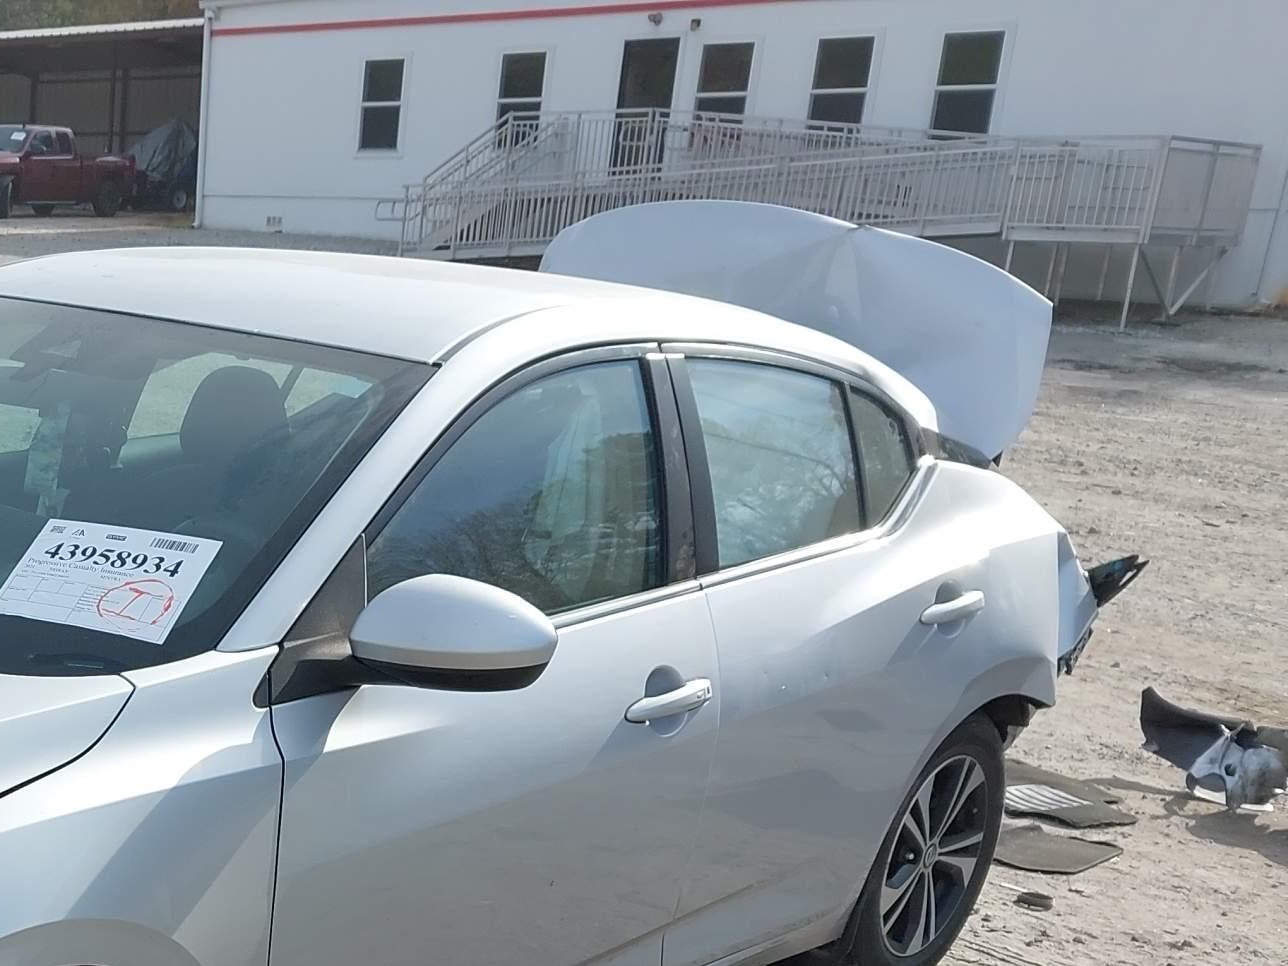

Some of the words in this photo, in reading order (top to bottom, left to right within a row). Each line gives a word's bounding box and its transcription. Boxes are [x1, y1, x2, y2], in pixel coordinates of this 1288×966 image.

[27, 558, 68, 568] Progressive
[68, 563, 98, 574] Casualty
[100, 567, 135, 578] Insurance
[45, 542, 185, 578] 43958934
